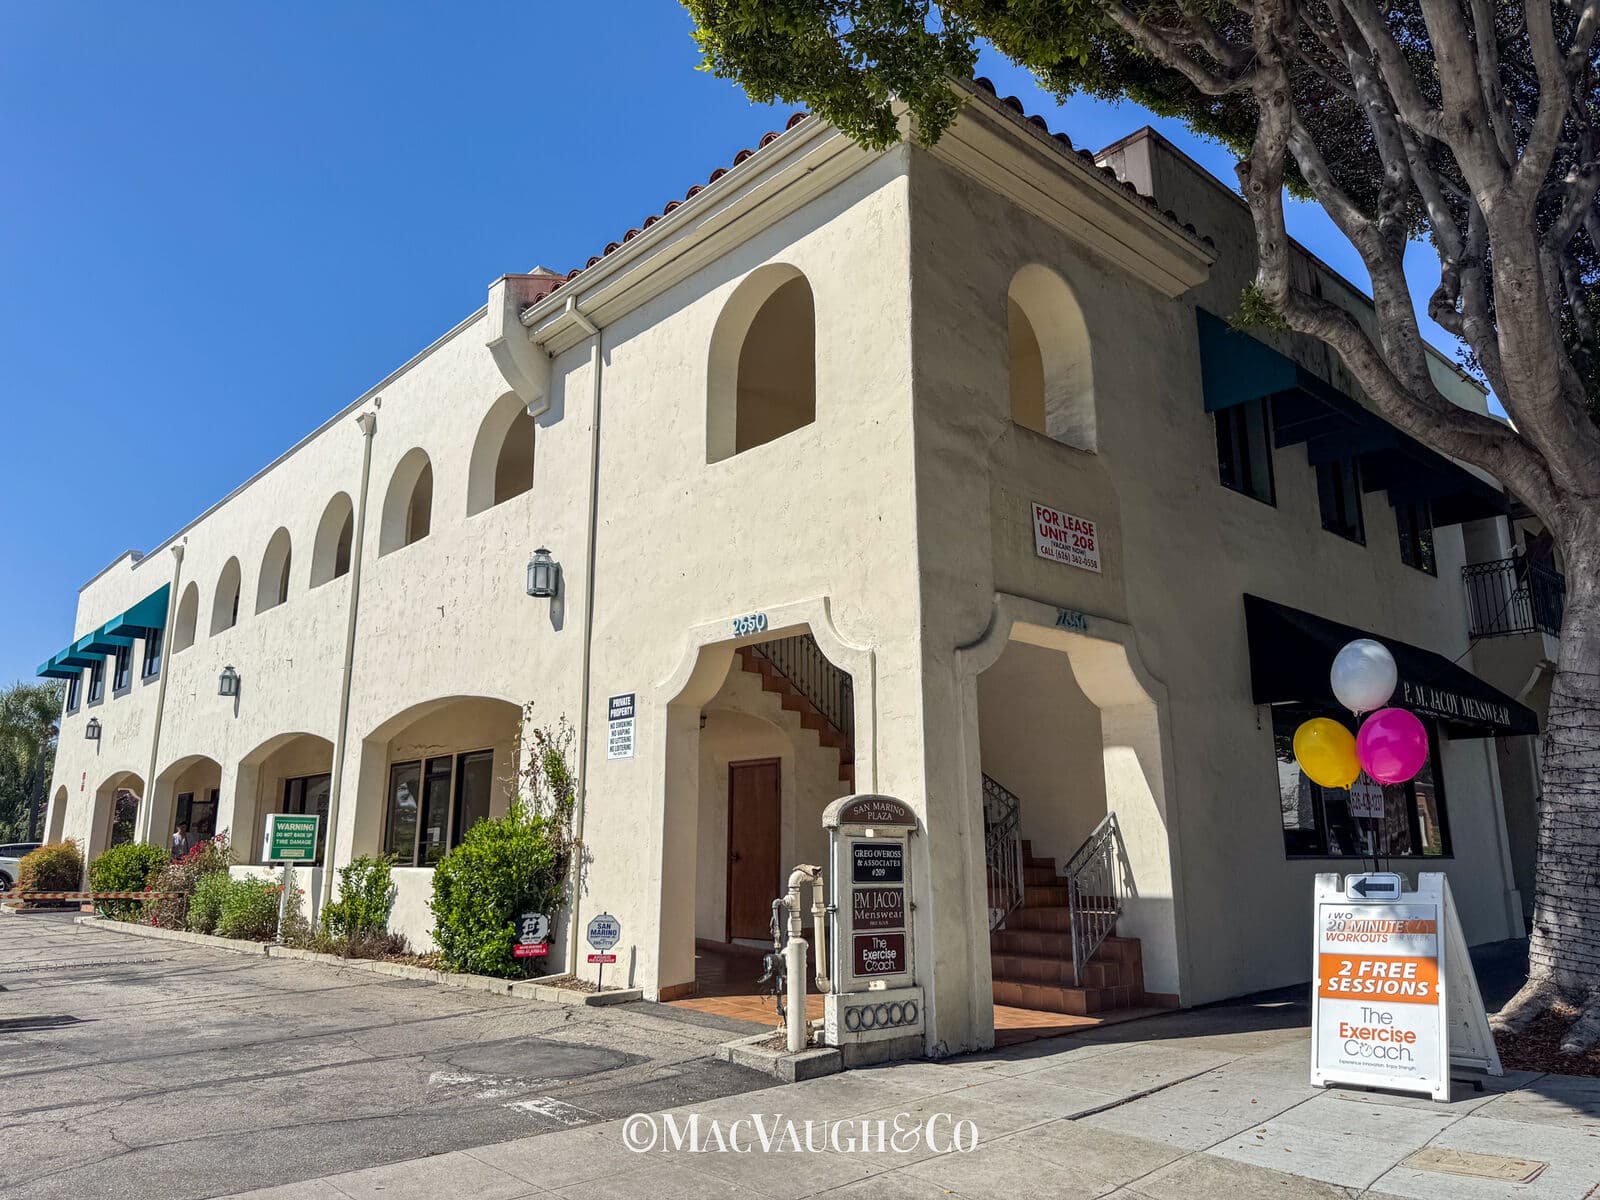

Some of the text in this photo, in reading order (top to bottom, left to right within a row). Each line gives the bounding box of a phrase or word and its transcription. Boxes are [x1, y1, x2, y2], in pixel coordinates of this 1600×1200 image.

[1036, 506, 1094, 537] FOR LEASE
[1039, 524, 1094, 551] UNIT 208
[1041, 545, 1054, 556] CALL
[1056, 549, 1070, 563] (626)
[733, 613, 766, 635] 2650
[613, 697, 631, 707] PRIVATE
[1404, 682, 1511, 725] P. M. JACOY MENSWEAR
[610, 706, 633, 719] PROPERTY
[853, 802, 905, 816] SAN MARINO
[867, 812, 892, 820] PLAZA
[277, 823, 314, 831] WARNING
[855, 850, 901, 858] GREG OVEROSS
[872, 868, 885, 877] #209
[873, 891, 903, 910] JACOY
[855, 910, 903, 920] Menswear
[1328, 912, 1353, 920] TWO
[872, 937, 887, 949] The
[1326, 932, 1388, 943] WORKOUTS
[863, 949, 897, 960] Exercise
[1338, 960, 1418, 979] 2 FREE
[1327, 978, 1429, 996] SESSIONS
[1361, 1006, 1393, 1025] The
[1339, 1022, 1417, 1044] Exercise
